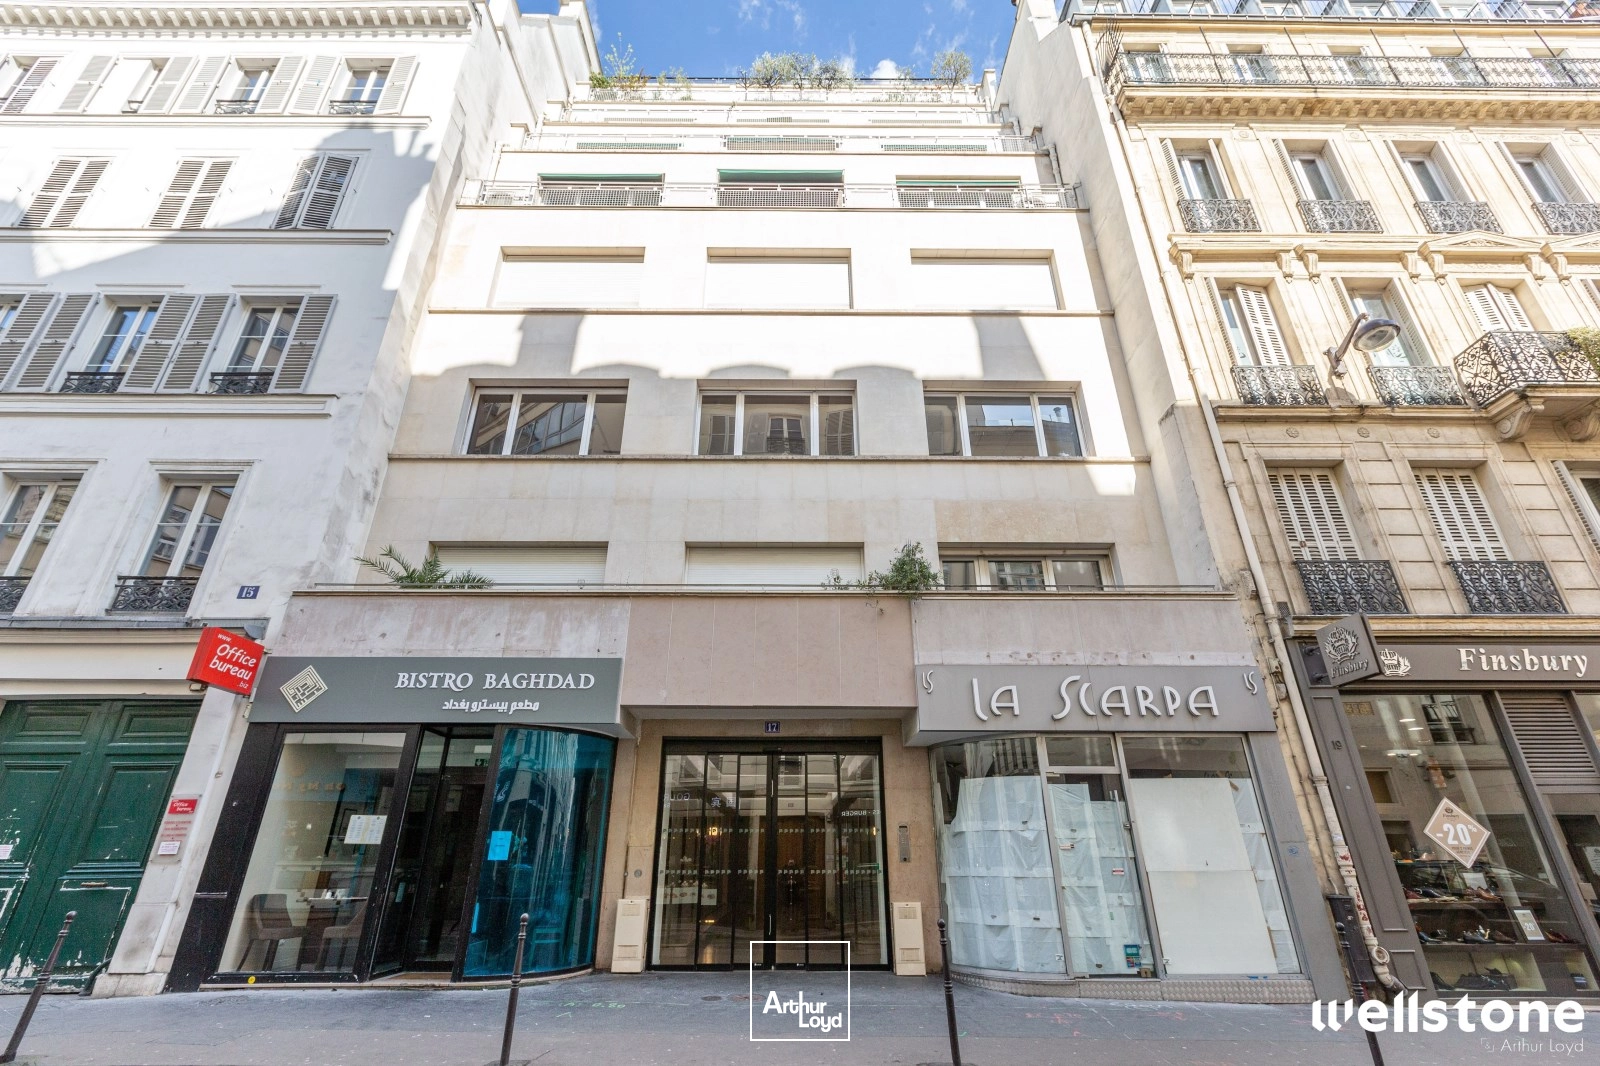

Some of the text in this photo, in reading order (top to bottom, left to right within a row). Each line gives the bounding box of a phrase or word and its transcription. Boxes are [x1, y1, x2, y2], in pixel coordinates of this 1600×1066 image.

[241, 586, 256, 598] 15
[216, 643, 257, 667] Office
[1457, 648, 1588, 678] Finsbury
[209, 655, 253, 680] bureau
[1331, 659, 1369, 679] Finsbury
[394, 671, 596, 692] BISTRO BAGHDAD
[442, 699, 469, 713] بغداد
[509, 699, 540, 715] مطعم
[971, 674, 1220, 722] LA SCARPA
